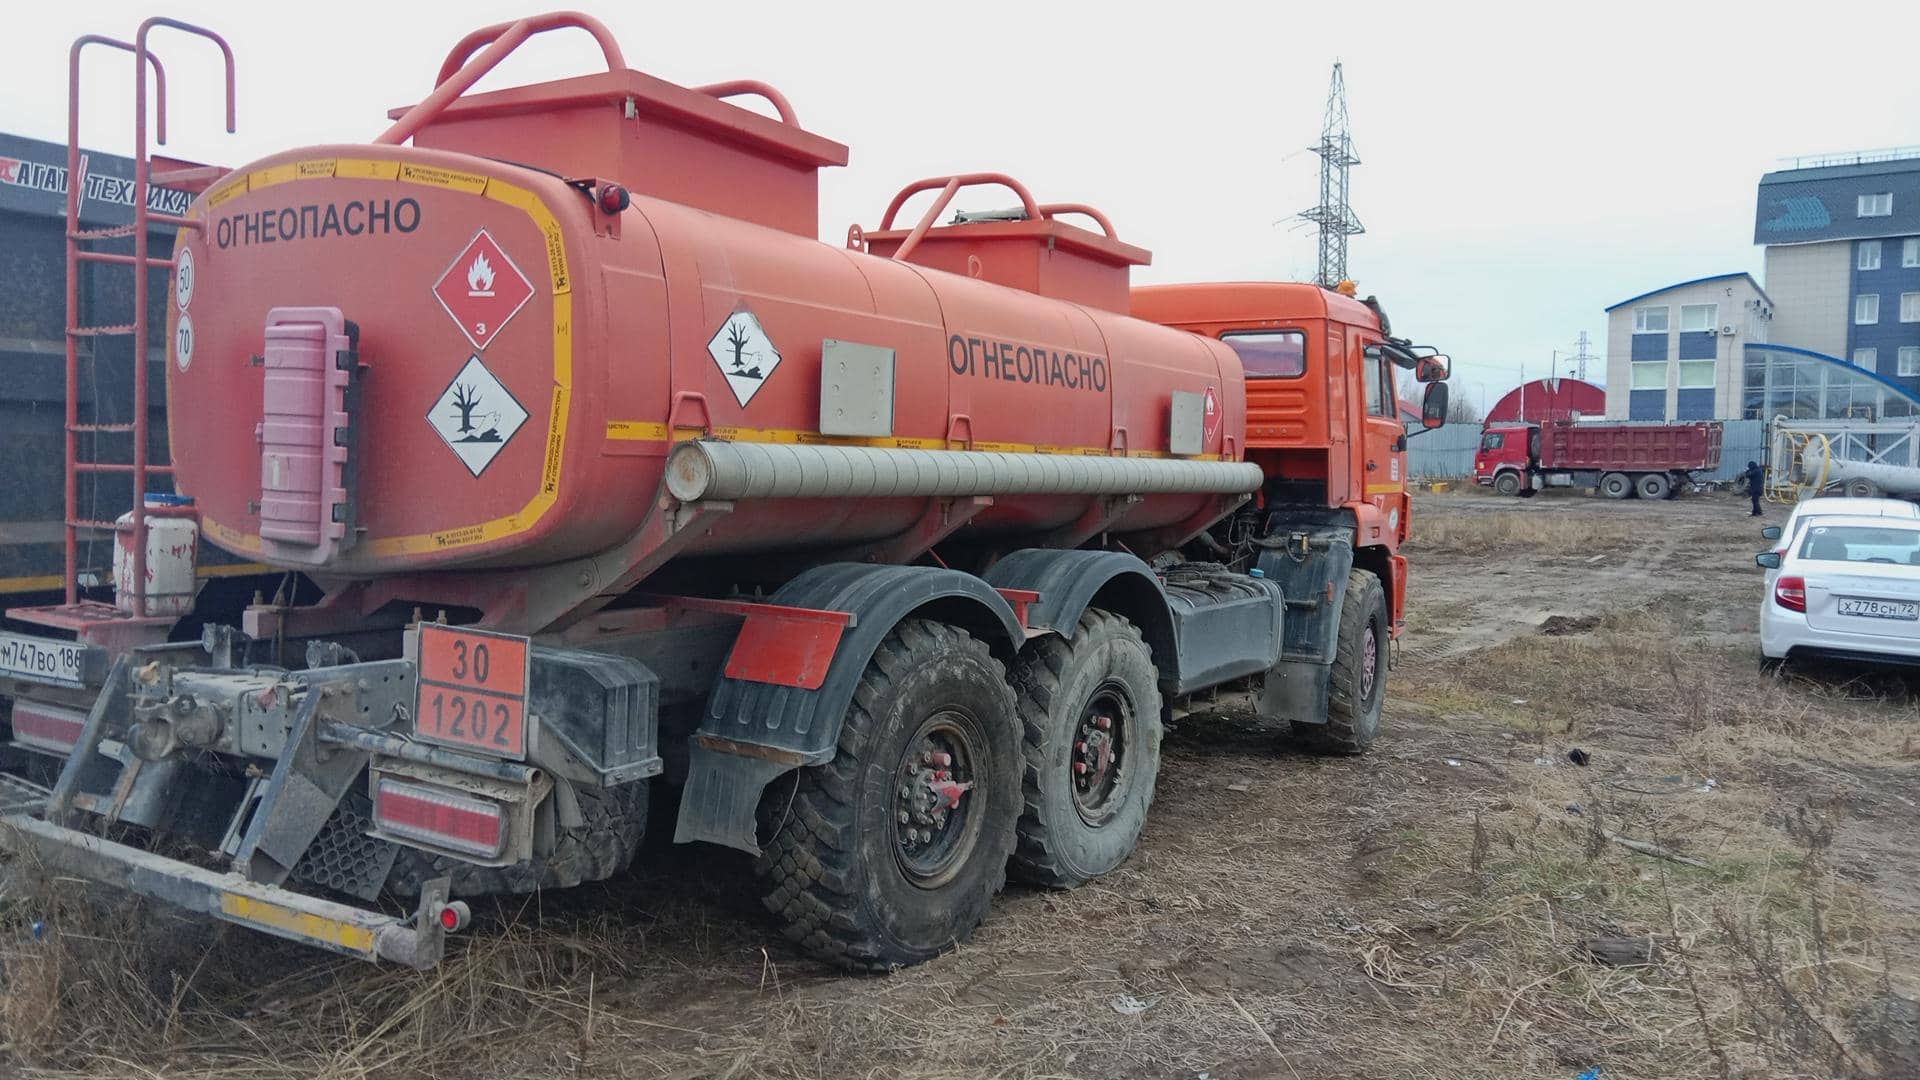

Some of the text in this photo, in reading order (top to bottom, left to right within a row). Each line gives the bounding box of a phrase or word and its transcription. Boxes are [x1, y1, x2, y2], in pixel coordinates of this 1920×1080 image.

[217, 198, 421, 250] ОГНЕОПАСНО
[180, 264, 190, 293] 50
[179, 329, 190, 354] 70
[475, 322, 486, 335] 3
[949, 334, 1106, 392] ОГНЕОПАСНО
[1902, 604, 1914, 613] 72
[452, 639, 489, 683] 30
[432, 692, 510, 746] 1202
